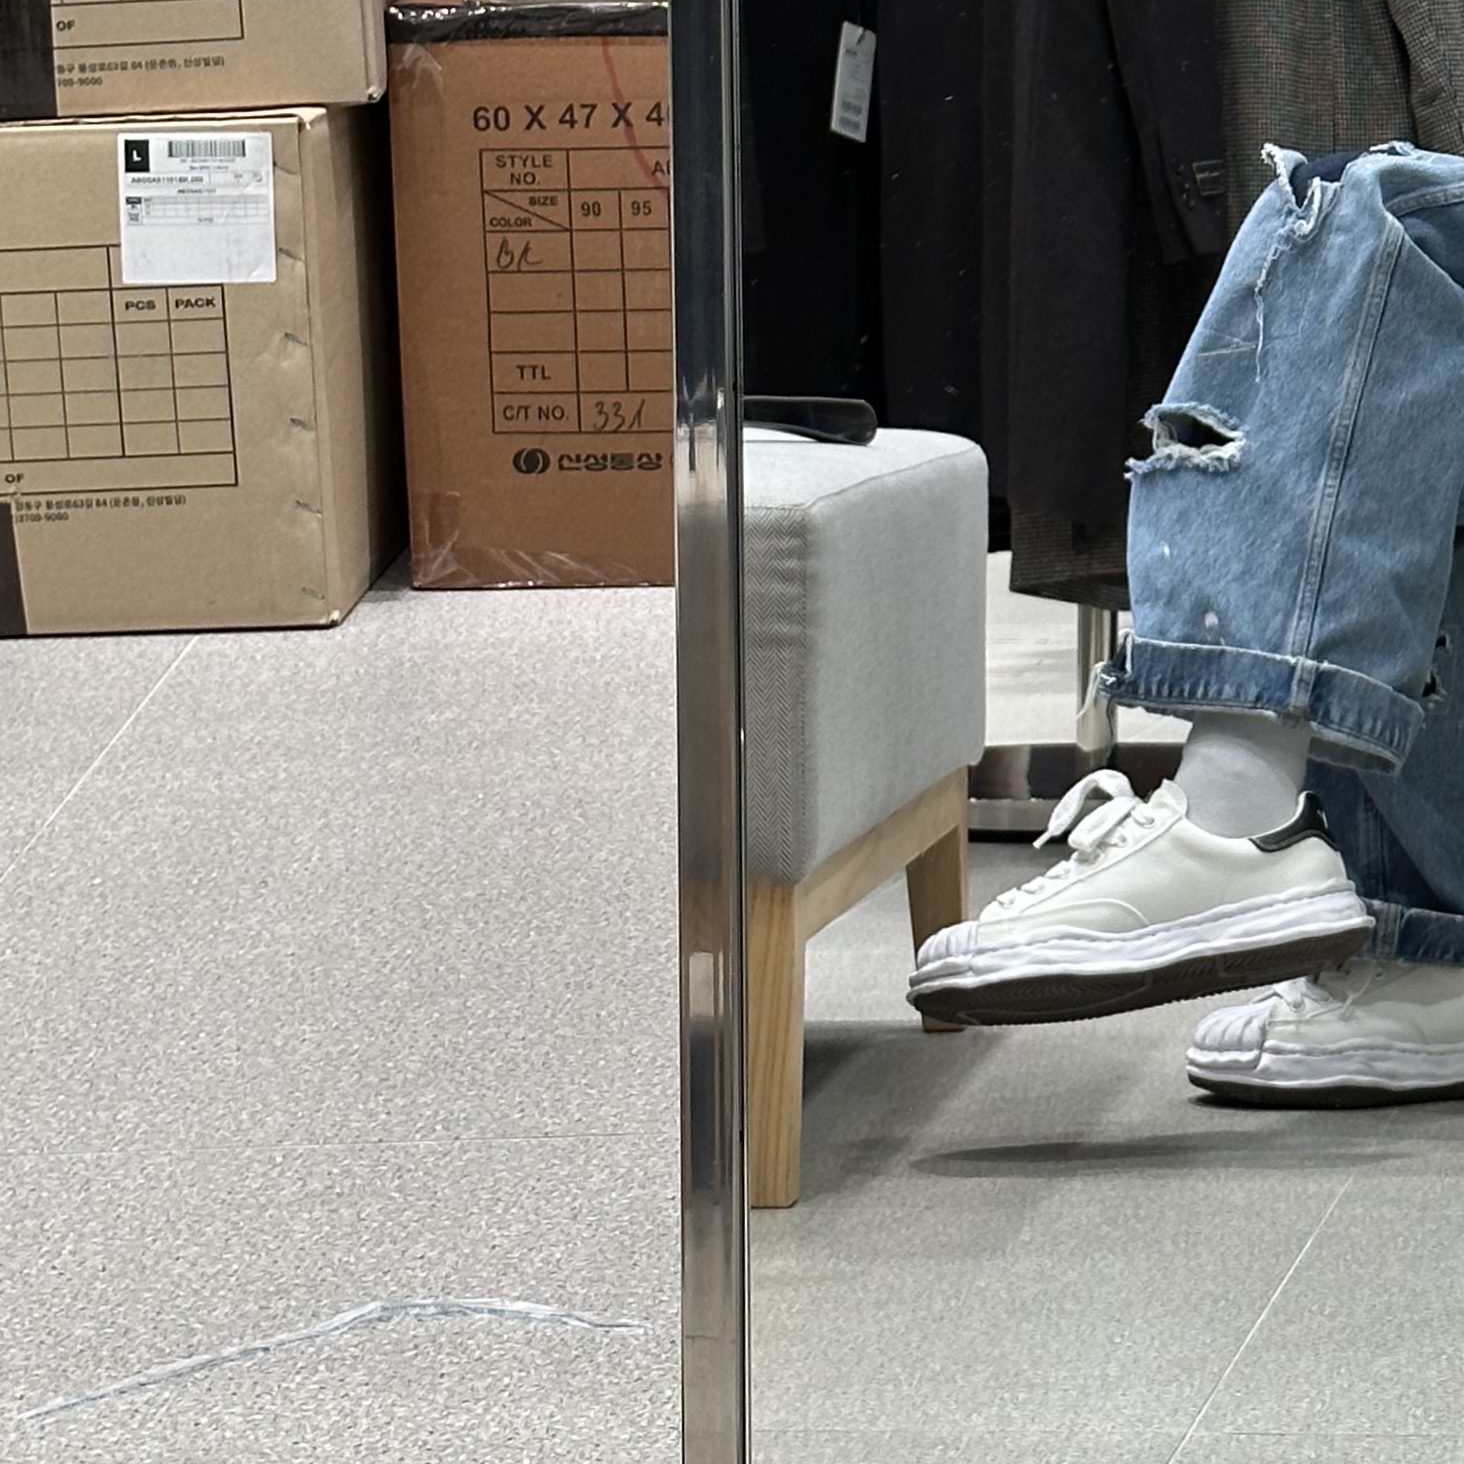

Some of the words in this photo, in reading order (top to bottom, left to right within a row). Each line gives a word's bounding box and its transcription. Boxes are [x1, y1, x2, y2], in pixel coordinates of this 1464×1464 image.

[56, 20, 75, 31] OF
[473, 106, 510, 131] 60
[558, 102, 598, 129] 47
[645, 101, 670, 127] 4
[132, 149, 142, 162] L
[495, 154, 553, 169] STYLE
[510, 172, 539, 185] NO.
[528, 196, 559, 206] SIZE
[580, 201, 601, 217] 90
[631, 200, 652, 216] 95
[489, 216, 532, 227] COLOR
[124, 300, 157, 311] PCS
[174, 297, 217, 309] PACK
[516, 364, 551, 380] TTL
[502, 405, 531, 421] C/T
[538, 405, 569, 420] NO.
[5, 473, 24, 483] OF
